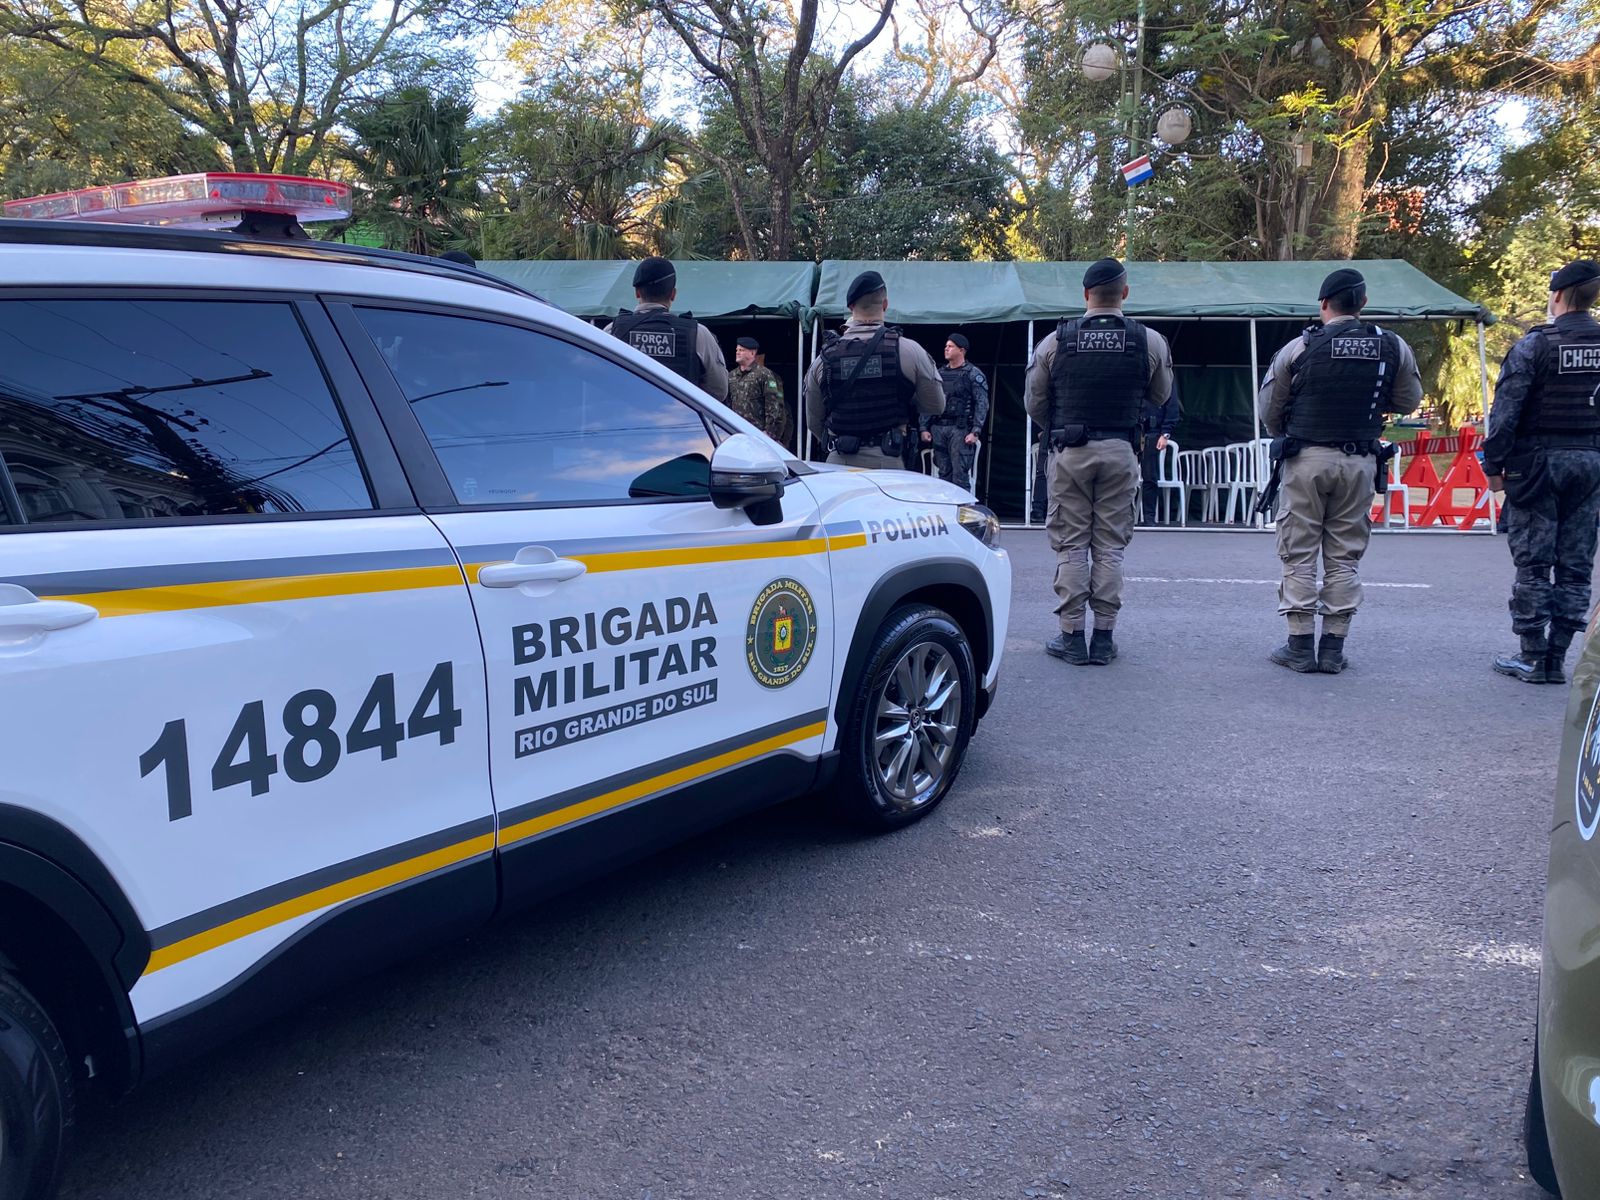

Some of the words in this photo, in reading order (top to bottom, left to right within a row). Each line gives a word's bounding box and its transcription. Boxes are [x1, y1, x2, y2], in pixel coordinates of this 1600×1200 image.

[635, 333, 669, 346] FORÇA
[1080, 339, 1122, 349] TÁTICA
[1084, 332, 1119, 342] FORÇA
[1338, 339, 1375, 348] FORÇA
[1334, 346, 1378, 356] TÁTICA
[843, 358, 878, 367] FOA
[843, 367, 881, 376] TICA
[867, 512, 949, 543] POLÍCIA
[750, 581, 783, 625] BRIGADA
[785, 580, 813, 616] MILITAR
[511, 592, 718, 666] BRIGADA
[747, 652, 758, 673] RIO
[757, 672, 790, 686] GRANDE
[791, 664, 802, 678] DO
[802, 640, 814, 664] SUL
[514, 636, 718, 716] MILITAR
[519, 727, 558, 753] RIO
[564, 702, 647, 740] GRANDE
[652, 696, 678, 716] DO
[682, 684, 715, 708] SUL
[139, 661, 462, 822] 14844
